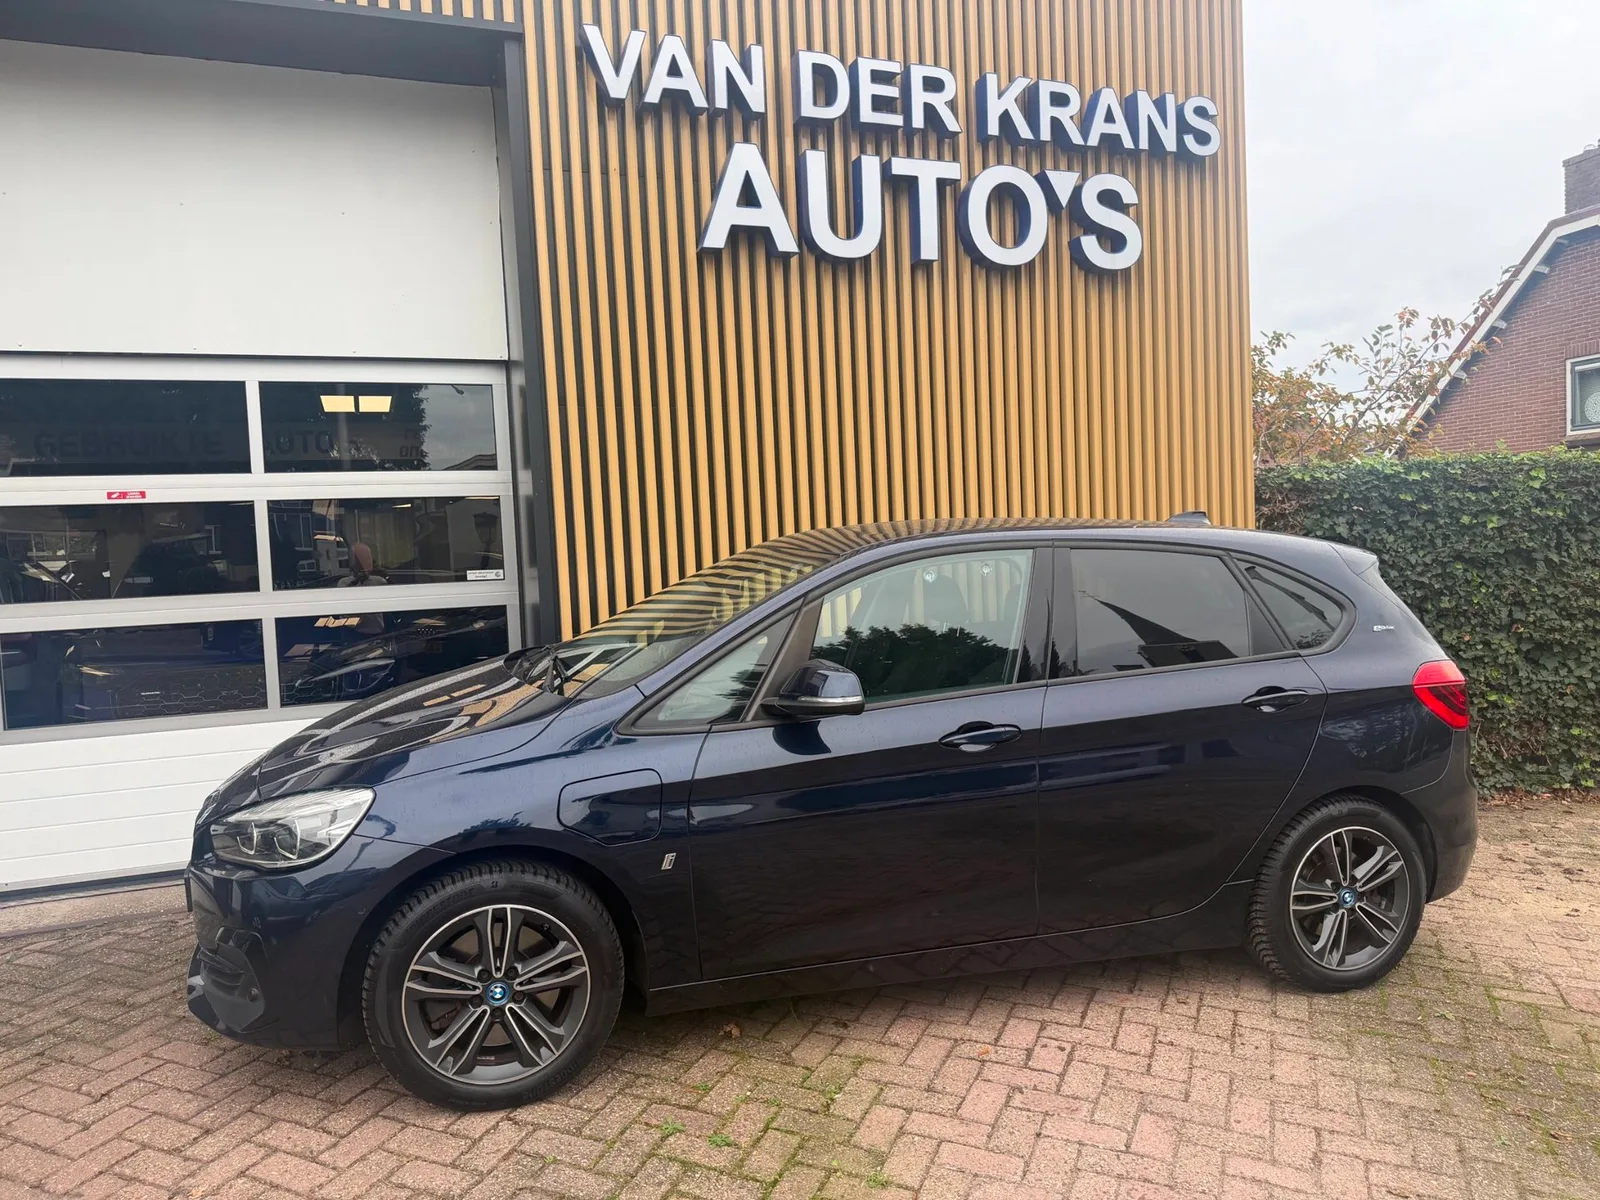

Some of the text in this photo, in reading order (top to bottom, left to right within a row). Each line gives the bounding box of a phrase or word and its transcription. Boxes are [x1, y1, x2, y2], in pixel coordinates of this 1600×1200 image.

[581, 23, 1221, 158] VAN DER KRANS
[699, 141, 1143, 271] AUTO'S
